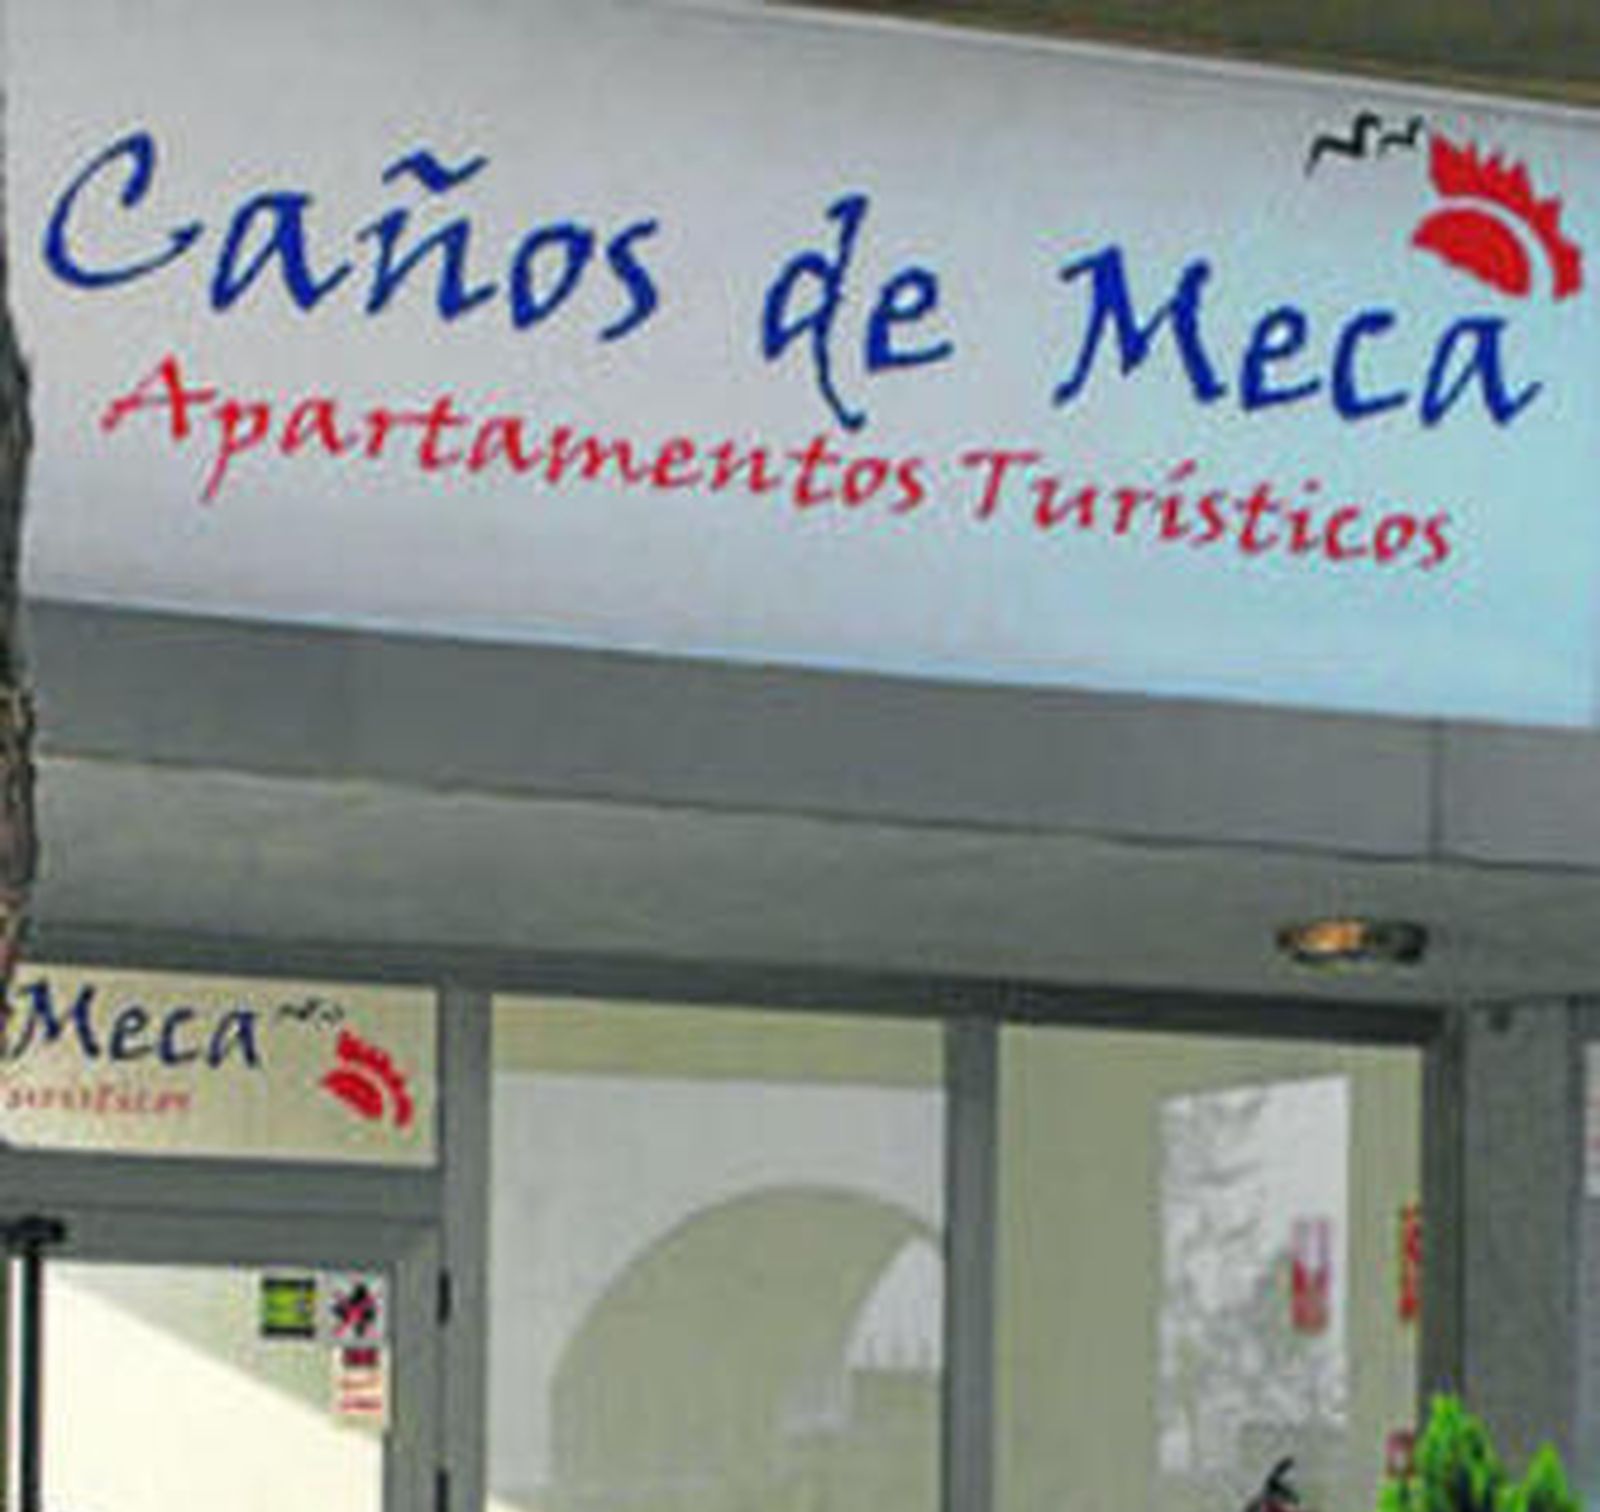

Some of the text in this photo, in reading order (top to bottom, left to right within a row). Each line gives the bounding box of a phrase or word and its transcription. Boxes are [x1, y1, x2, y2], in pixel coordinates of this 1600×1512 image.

[44, 130, 1542, 432] Caños de Meca
[101, 352, 1454, 570] Apartamentos Turísticos
[9, 978, 262, 1069] Meca
